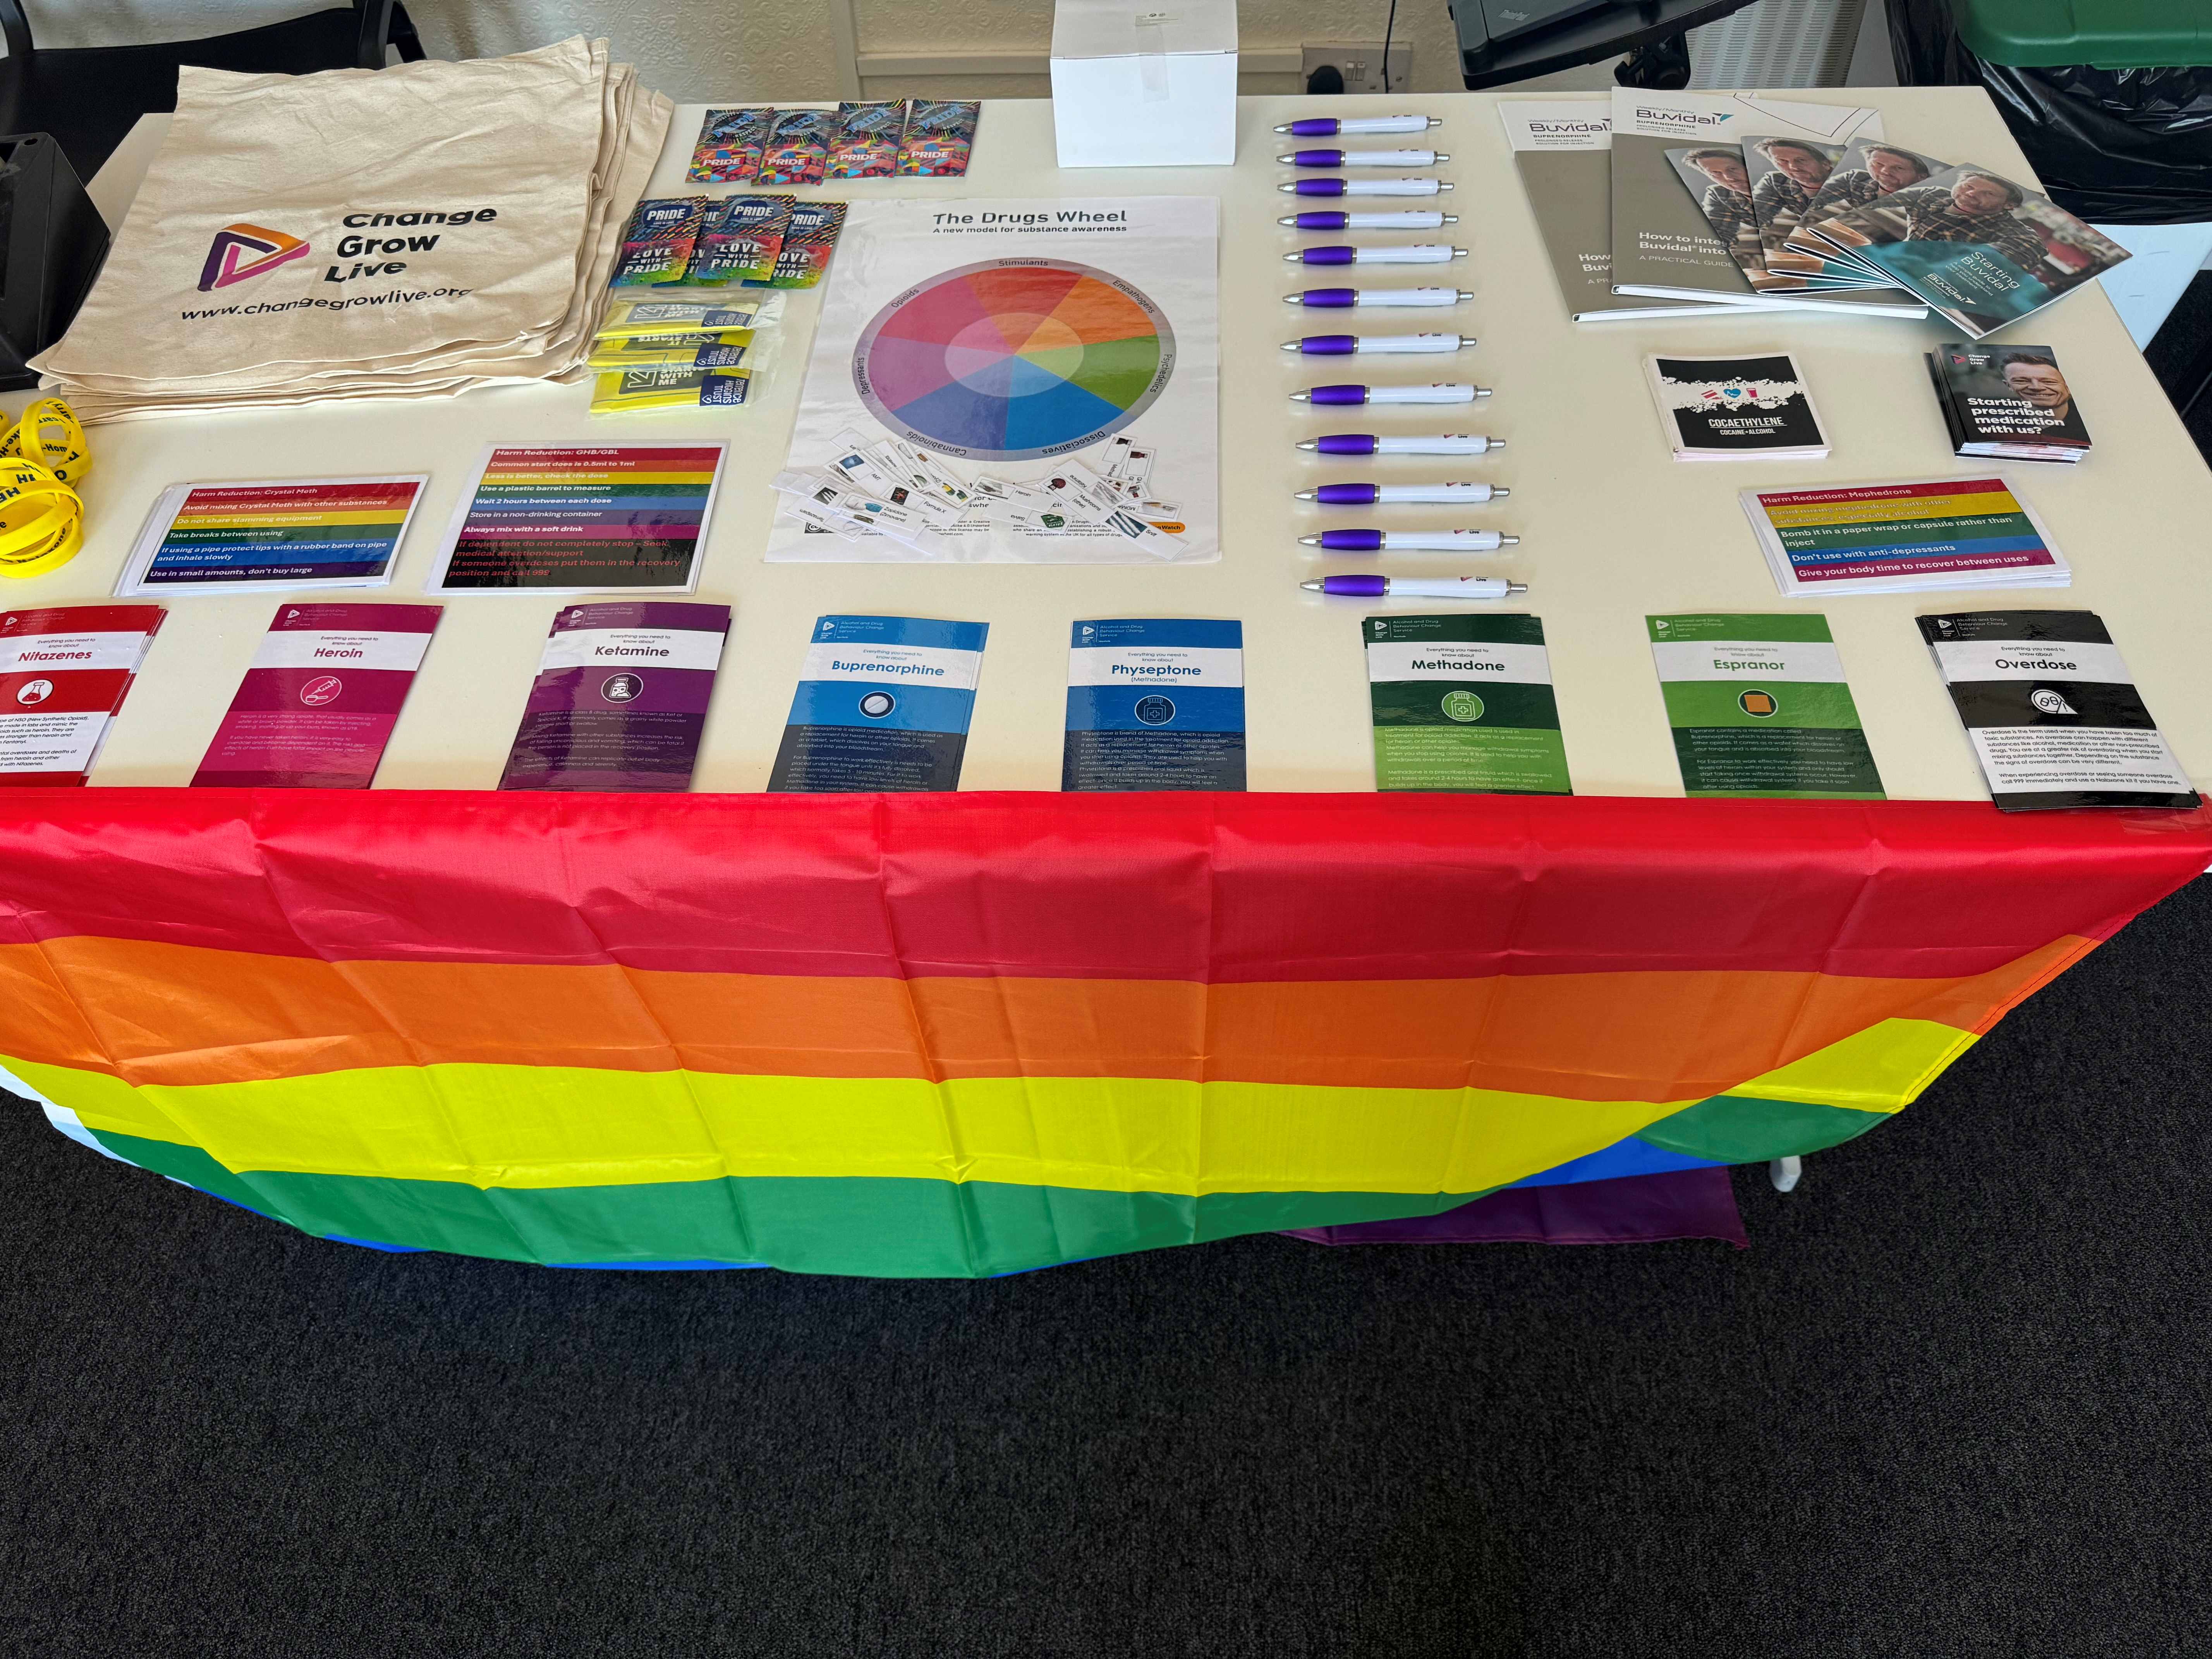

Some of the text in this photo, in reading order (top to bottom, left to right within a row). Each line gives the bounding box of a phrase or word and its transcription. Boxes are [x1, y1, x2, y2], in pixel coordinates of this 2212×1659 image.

[1529, 123, 1608, 131] Buvidal
[647, 209, 685, 220] PRIDE
[734, 206, 774, 217] PRIDE
[343, 208, 497, 228] Change
[933, 211, 1127, 225] The Drugs Wheel
[1639, 232, 1673, 240] How
[337, 234, 441, 258] Grow
[720, 243, 761, 253] LOVE
[1698, 246, 1726, 255] into
[633, 248, 673, 258] LOVE
[779, 252, 810, 262] OVE
[711, 259, 760, 270] PRIDE
[1649, 256, 1701, 264] PRACTICAL
[324, 261, 407, 283] Live
[623, 262, 671, 275] PRIDE
[773, 269, 807, 279] RIDE
[1961, 257, 2009, 291] Buvidal
[1972, 252, 2020, 289] Starting
[1927, 274, 1965, 301] Buvidal
[891, 289, 919, 308] Opioids
[1113, 280, 1154, 313] Empathogens
[858, 357, 870, 395] Depressants
[1150, 354, 1172, 393] Psychedelics
[733, 379, 745, 403] Terrence
[1967, 398, 2032, 408] Starting
[1708, 417, 1784, 427] COCAETHYLENE
[1975, 417, 2065, 426] medication
[907, 431, 967, 455] Cannabinoids
[1042, 431, 1106, 455] Dissociatives
[1763, 489, 1912, 503] Harm Reduction: Mephedrone
[923, 501, 940, 512] Formula
[1079, 494, 1101, 511] Mushrooms
[1844, 526, 1871, 535] paper
[1914, 521, 1954, 529] capsule
[1785, 539, 1815, 548] inject
[1868, 544, 1956, 556] anti-depressants
[1825, 568, 1846, 577] your
[1850, 565, 1874, 574] body
[1915, 561, 1954, 569] recover
[1956, 558, 2002, 566] between
[18, 650, 92, 661] Nitazenes
[314, 648, 363, 658] Heroin
[595, 646, 670, 657] Ketamine
[832, 660, 944, 675] Buprenorphine
[1112, 664, 1201, 677] Physeptone
[1412, 660, 1505, 671] Methadone
[1714, 659, 1785, 671] Espranor
[1995, 659, 2077, 670] Overdose
